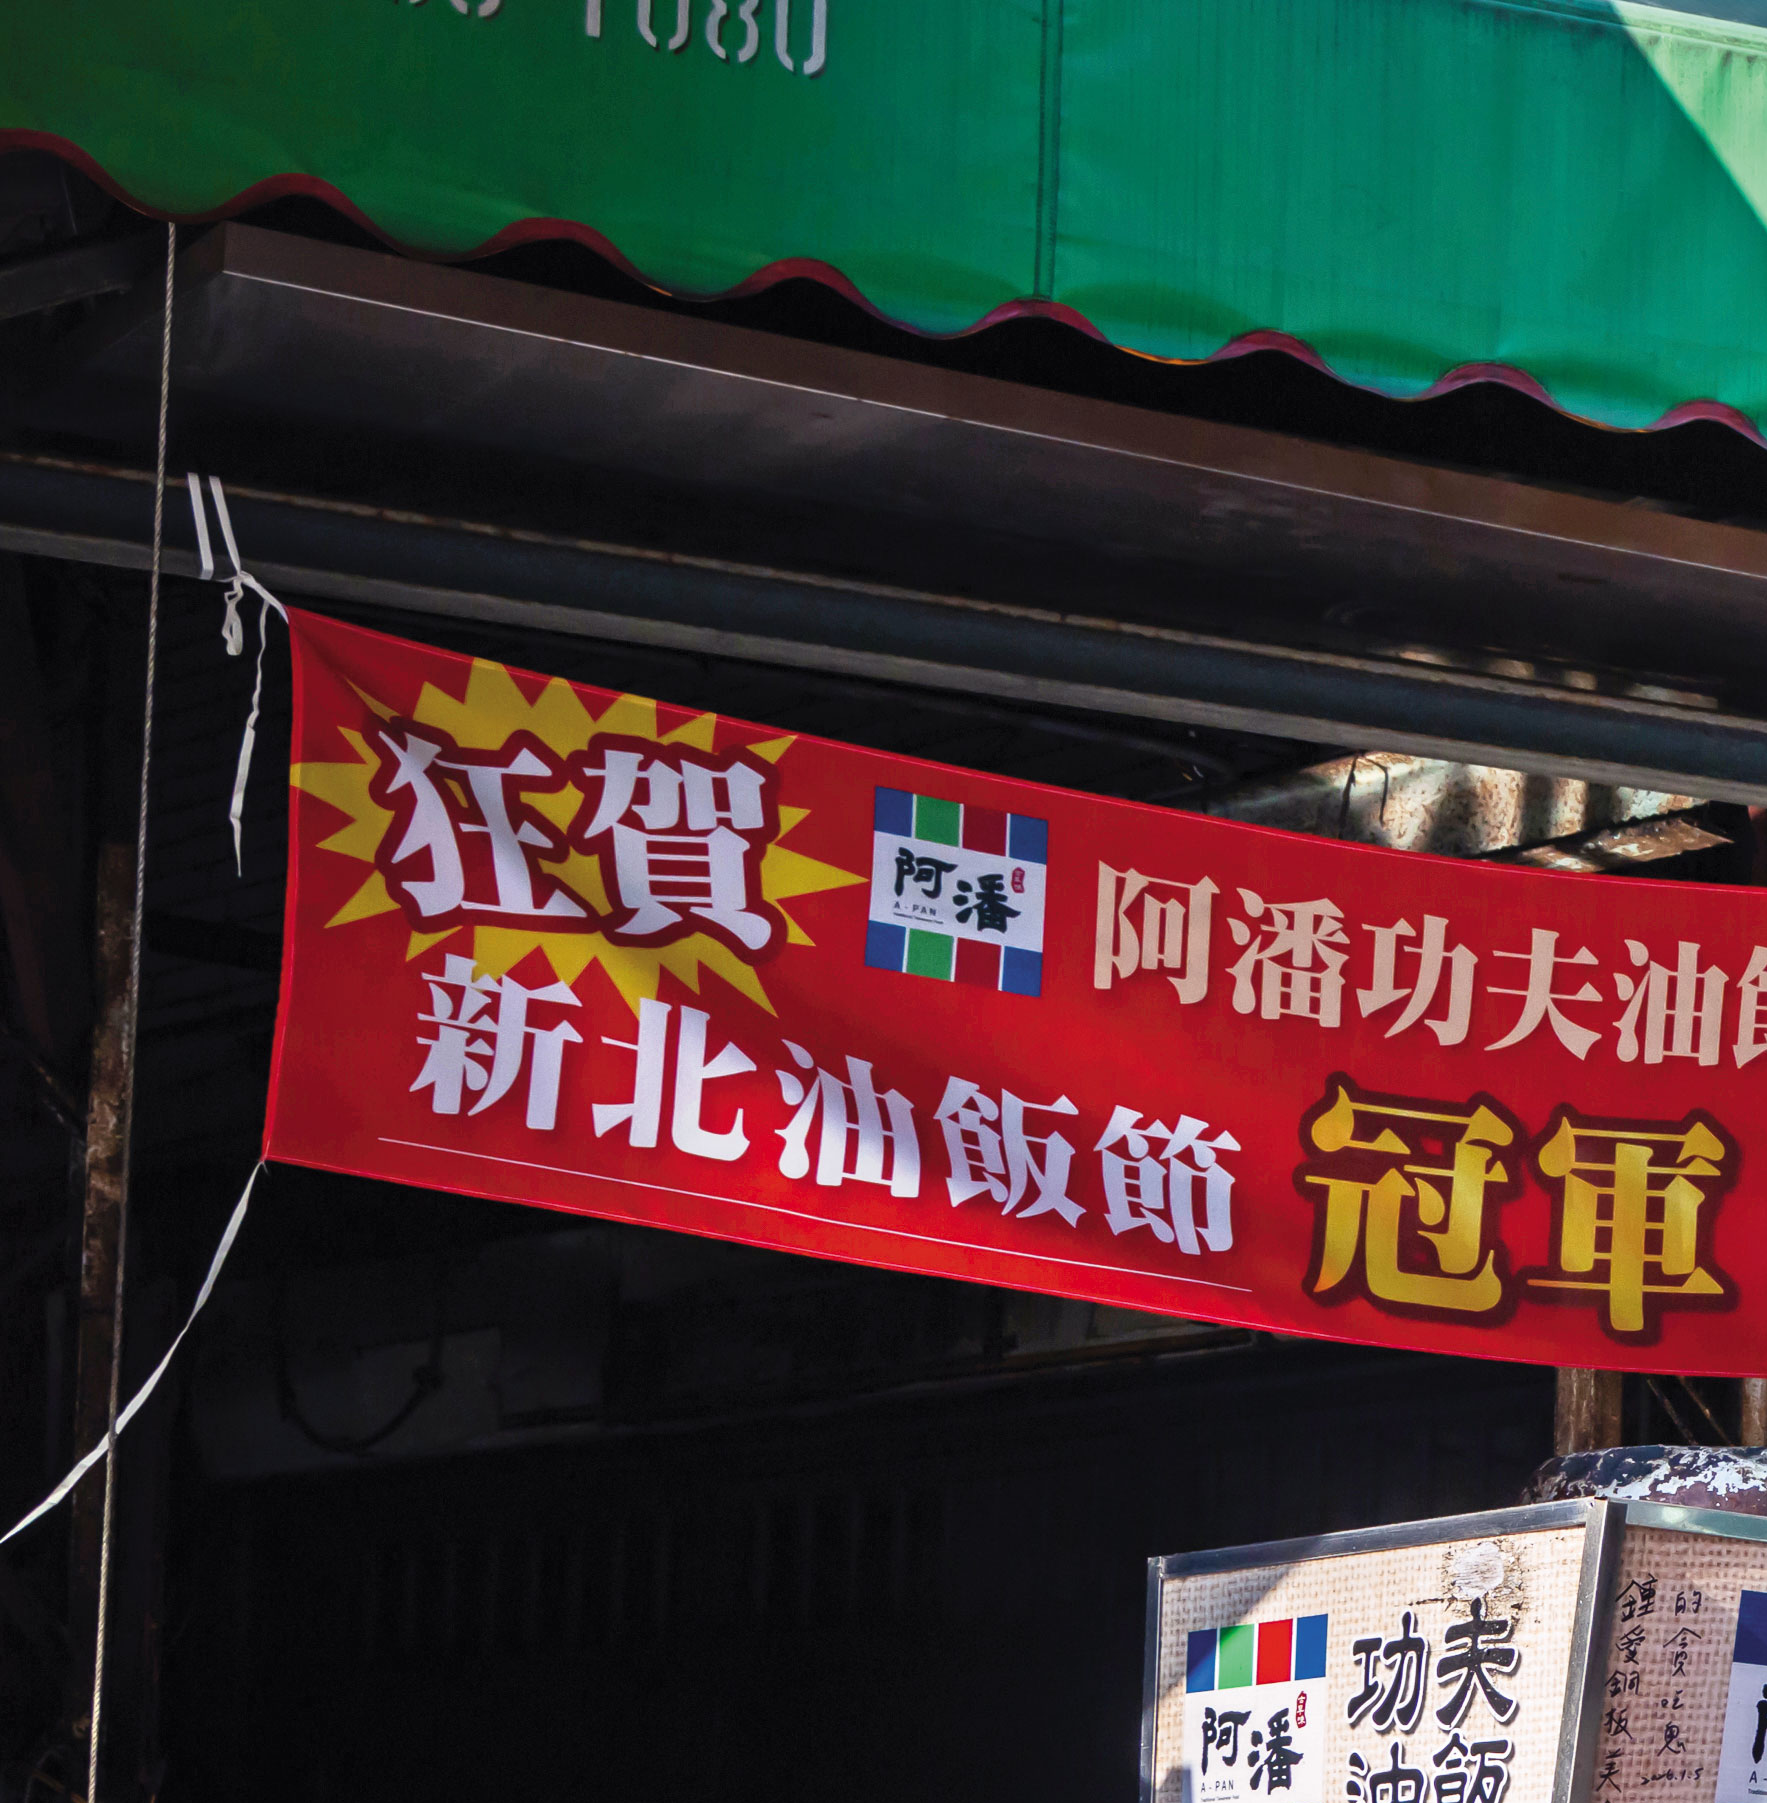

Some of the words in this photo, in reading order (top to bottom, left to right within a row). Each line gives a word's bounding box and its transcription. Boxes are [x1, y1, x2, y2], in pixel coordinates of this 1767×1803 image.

[376, 731, 772, 950] 狂賀
[894, 846, 1022, 934] 阿潘
[409, 953, 1241, 1256] 新北油飯節
[1346, 1597, 1518, 1732] 功夫
[1201, 1706, 1304, 1796] 阿潘
